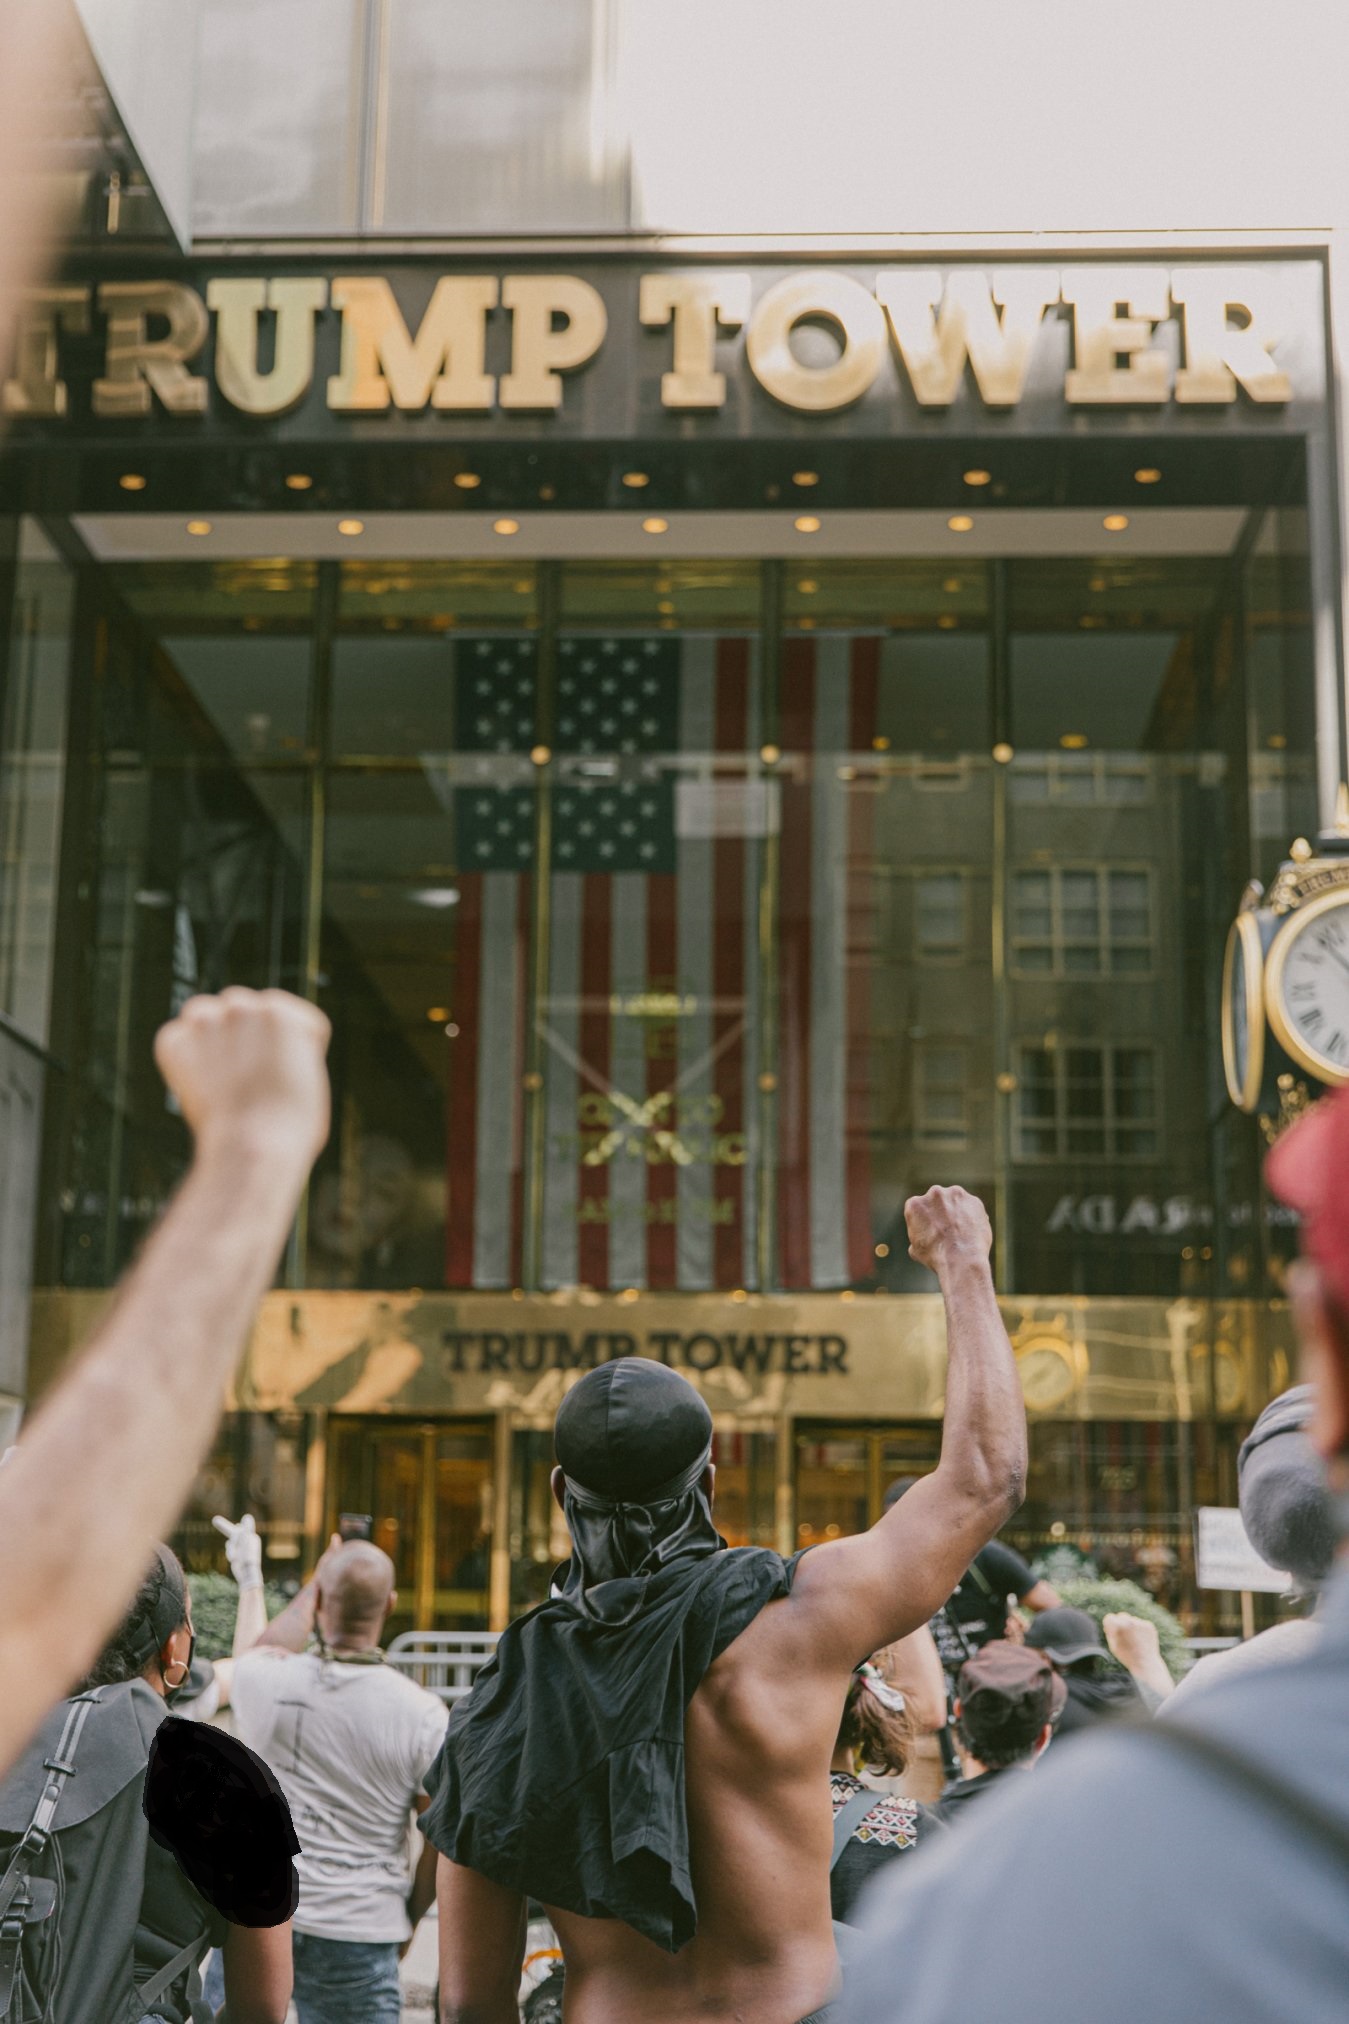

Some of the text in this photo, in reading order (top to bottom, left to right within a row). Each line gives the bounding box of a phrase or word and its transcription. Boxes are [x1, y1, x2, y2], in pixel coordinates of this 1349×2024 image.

[1, 268, 1292, 414] TRUMP TOWER
[442, 1331, 849, 1374] TRUMP TOWER
